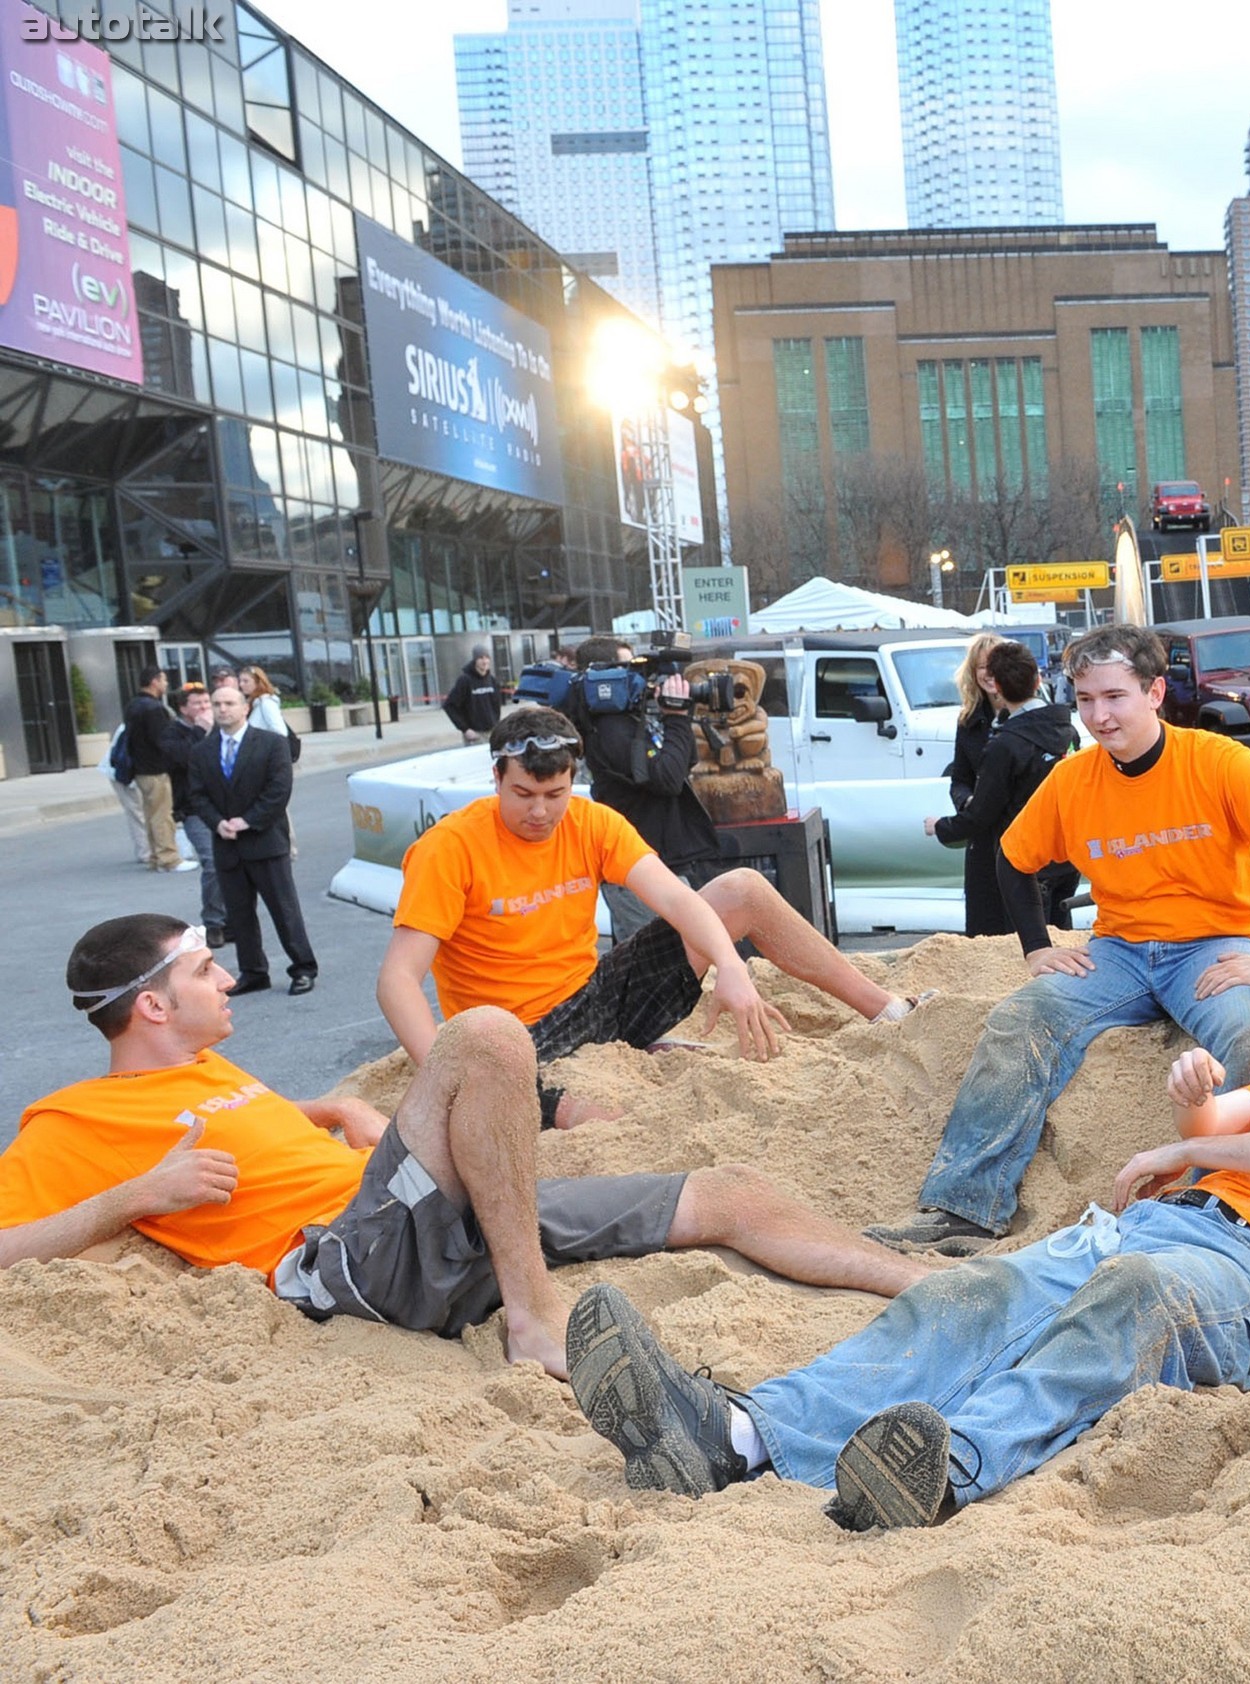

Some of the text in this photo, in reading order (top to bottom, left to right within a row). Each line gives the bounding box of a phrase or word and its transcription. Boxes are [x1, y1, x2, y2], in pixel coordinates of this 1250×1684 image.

[48, 160, 117, 209] INDOOR
[366, 256, 437, 327] Everything
[33, 293, 131, 345] PAVILION
[405, 344, 470, 415] SIRIUS
[411, 408, 494, 451] SATELLITE
[694, 577, 734, 588] ENTER
[699, 592, 731, 602] HERE
[1033, 571, 1096, 583] SUSPENSION
